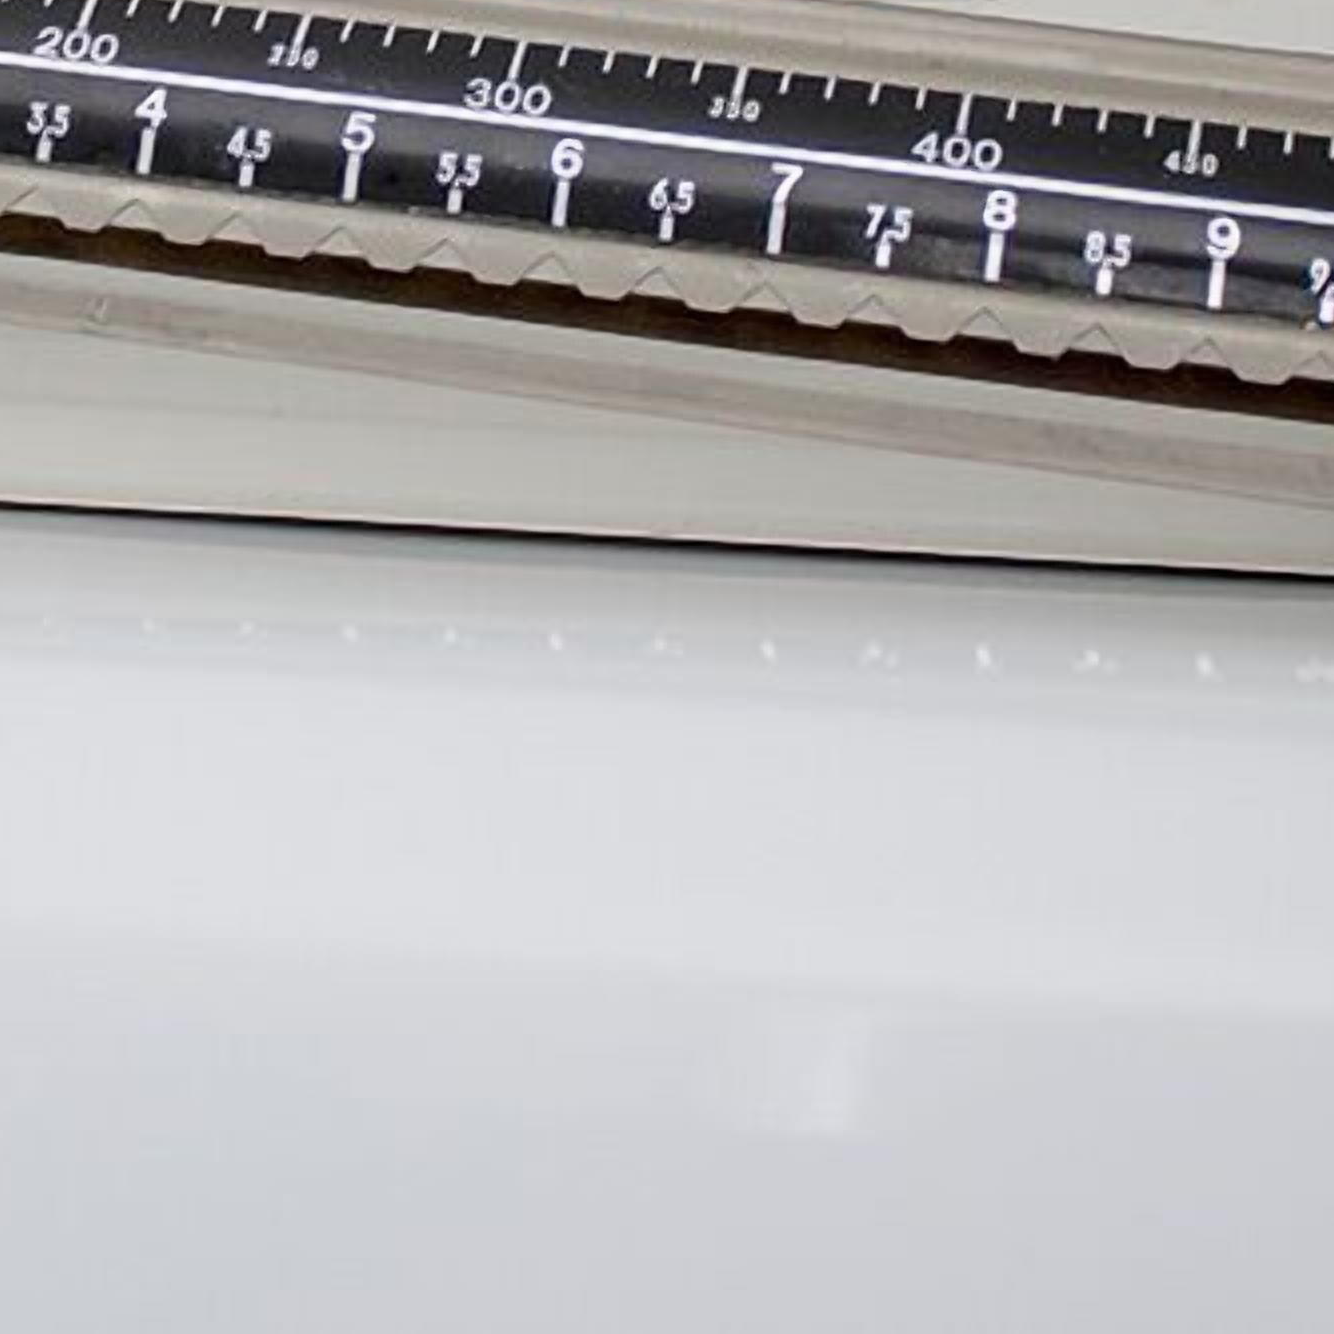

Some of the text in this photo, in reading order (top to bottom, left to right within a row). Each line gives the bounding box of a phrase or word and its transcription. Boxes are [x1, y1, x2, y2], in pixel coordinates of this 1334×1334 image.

[33, 27, 119, 66] 200
[466, 77, 552, 116] 300
[910, 131, 1004, 171] 400
[134, 86, 169, 127] 4
[340, 111, 376, 153] 5
[550, 137, 586, 180] 6
[770, 162, 805, 204] 7
[982, 189, 1019, 232] 8
[1206, 217, 1242, 260] 9
